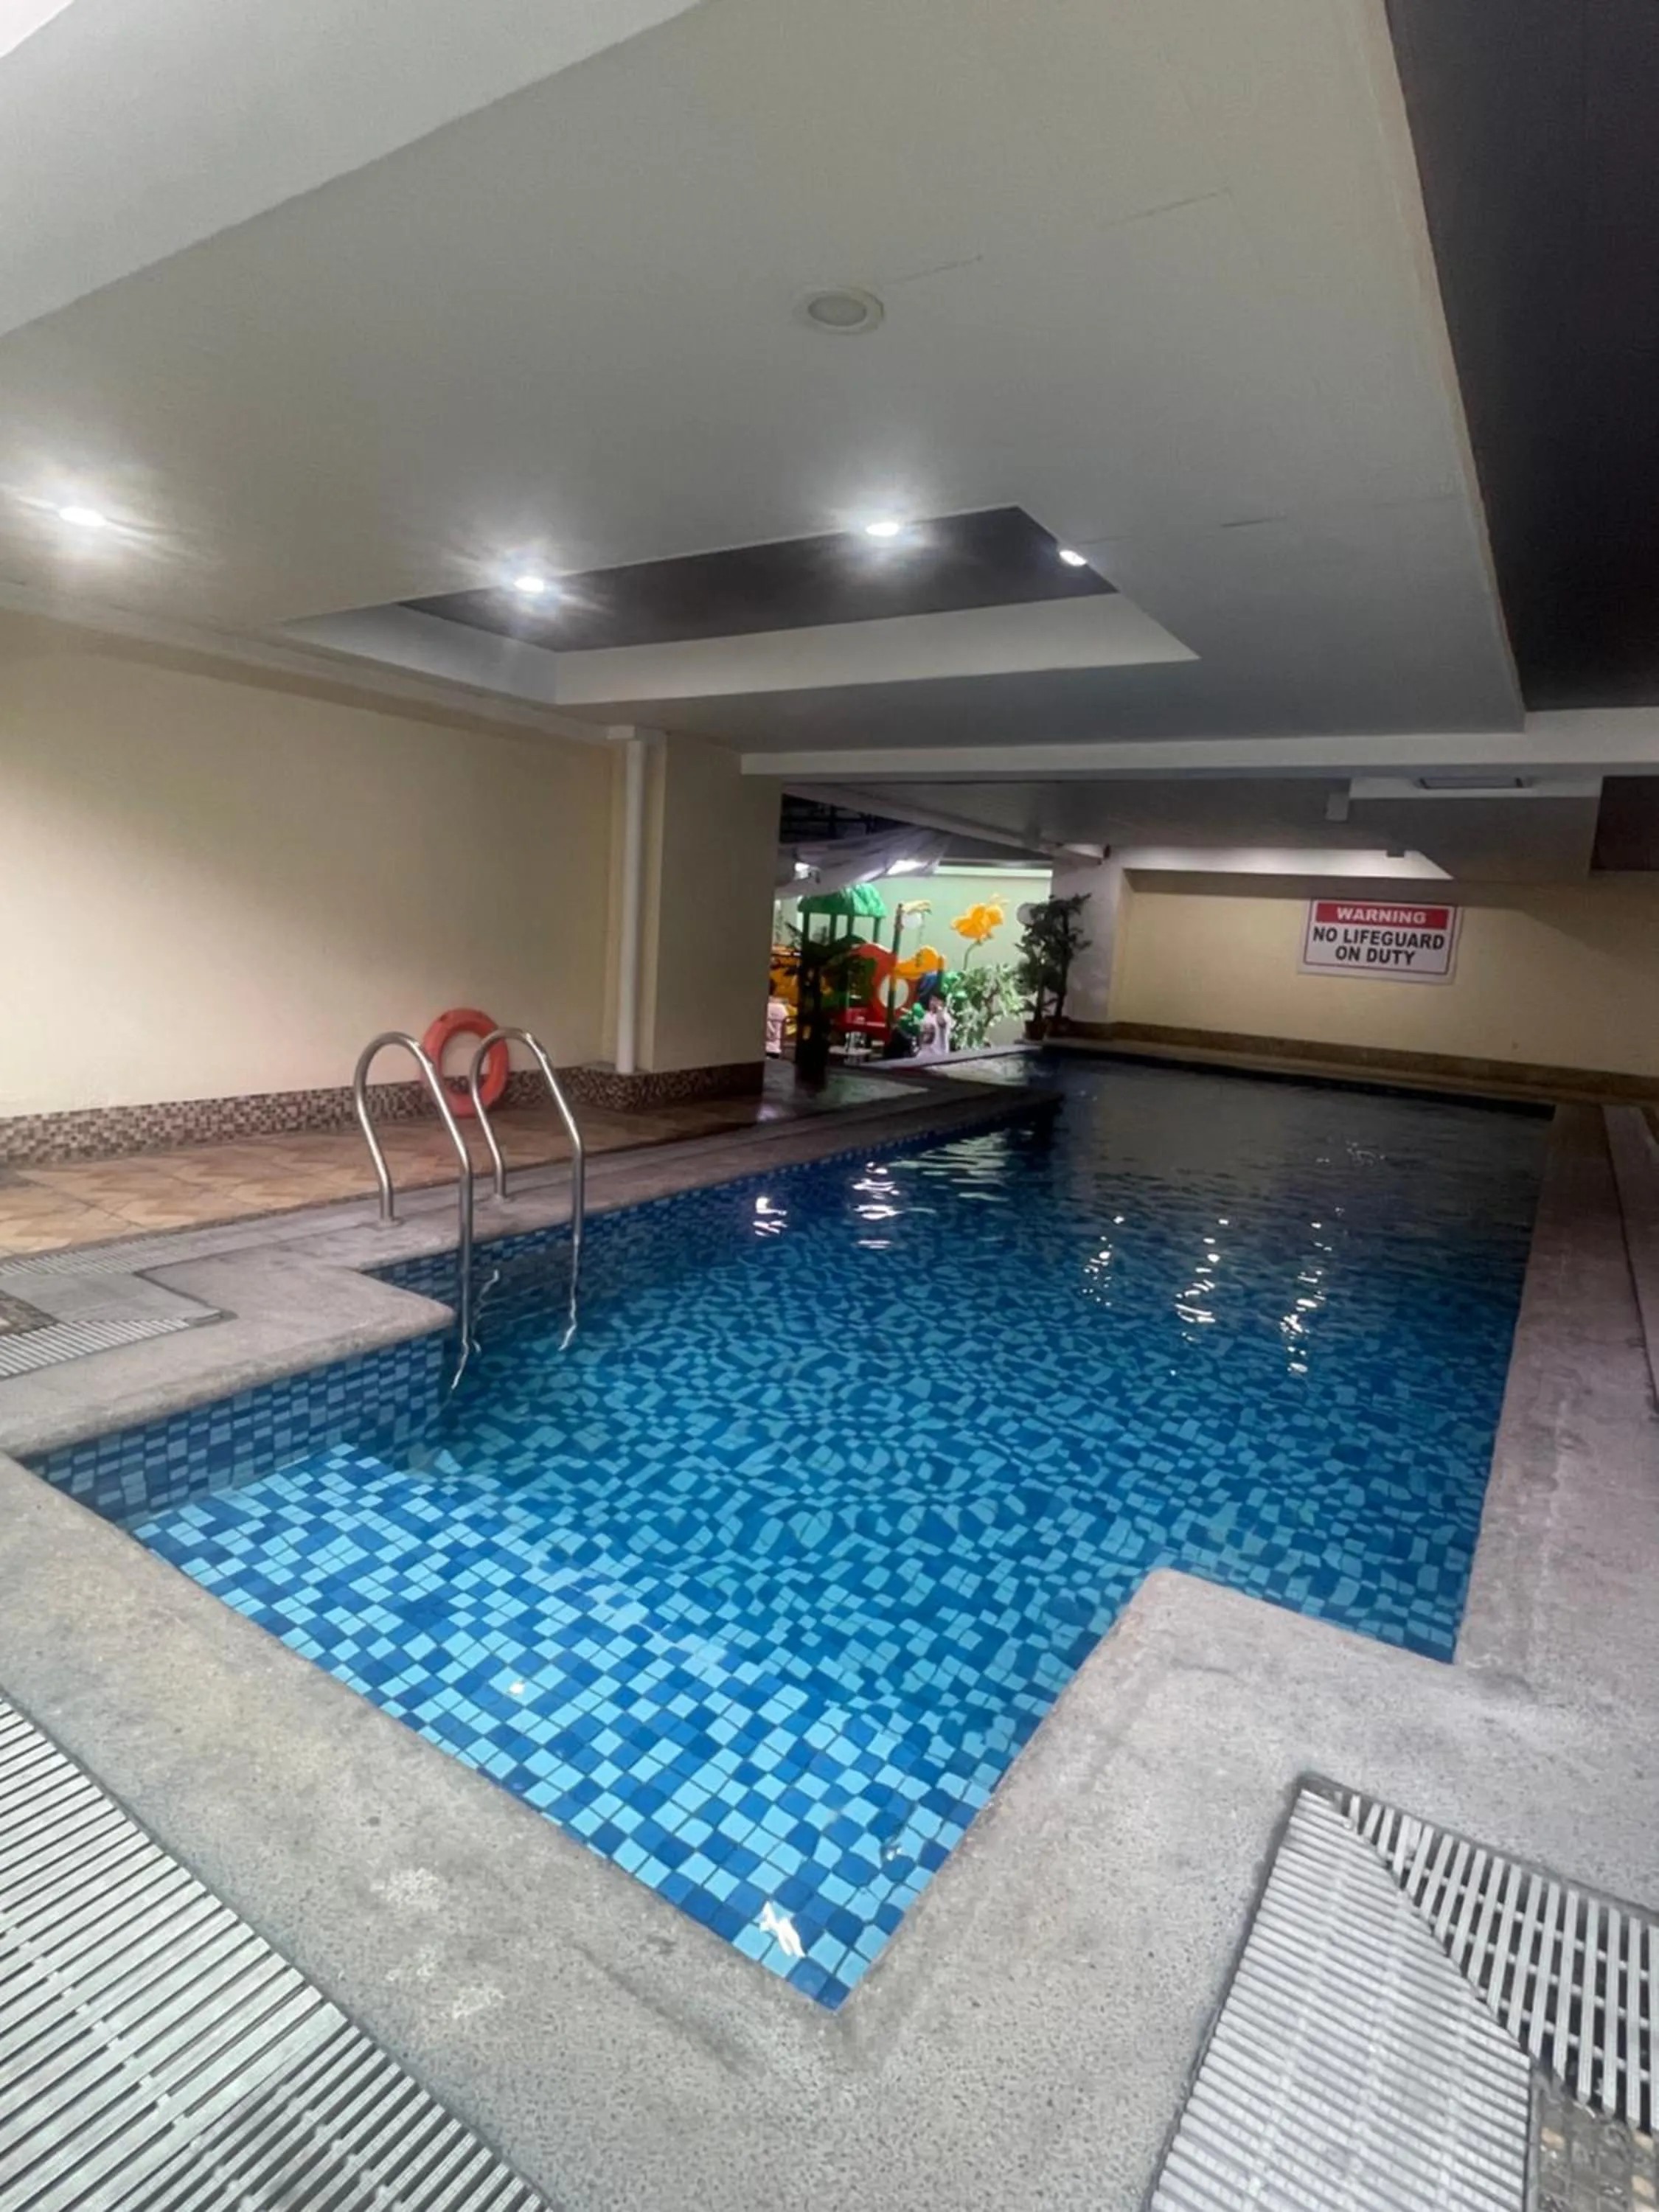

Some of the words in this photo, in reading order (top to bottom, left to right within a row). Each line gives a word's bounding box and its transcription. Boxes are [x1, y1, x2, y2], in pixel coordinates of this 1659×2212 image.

[1336, 906, 1427, 925] WARNING
[1312, 926, 1338, 942] NO
[1343, 928, 1444, 950] LIFEGUARD
[1335, 946, 1360, 962] ON
[1366, 947, 1416, 966] DUTY
